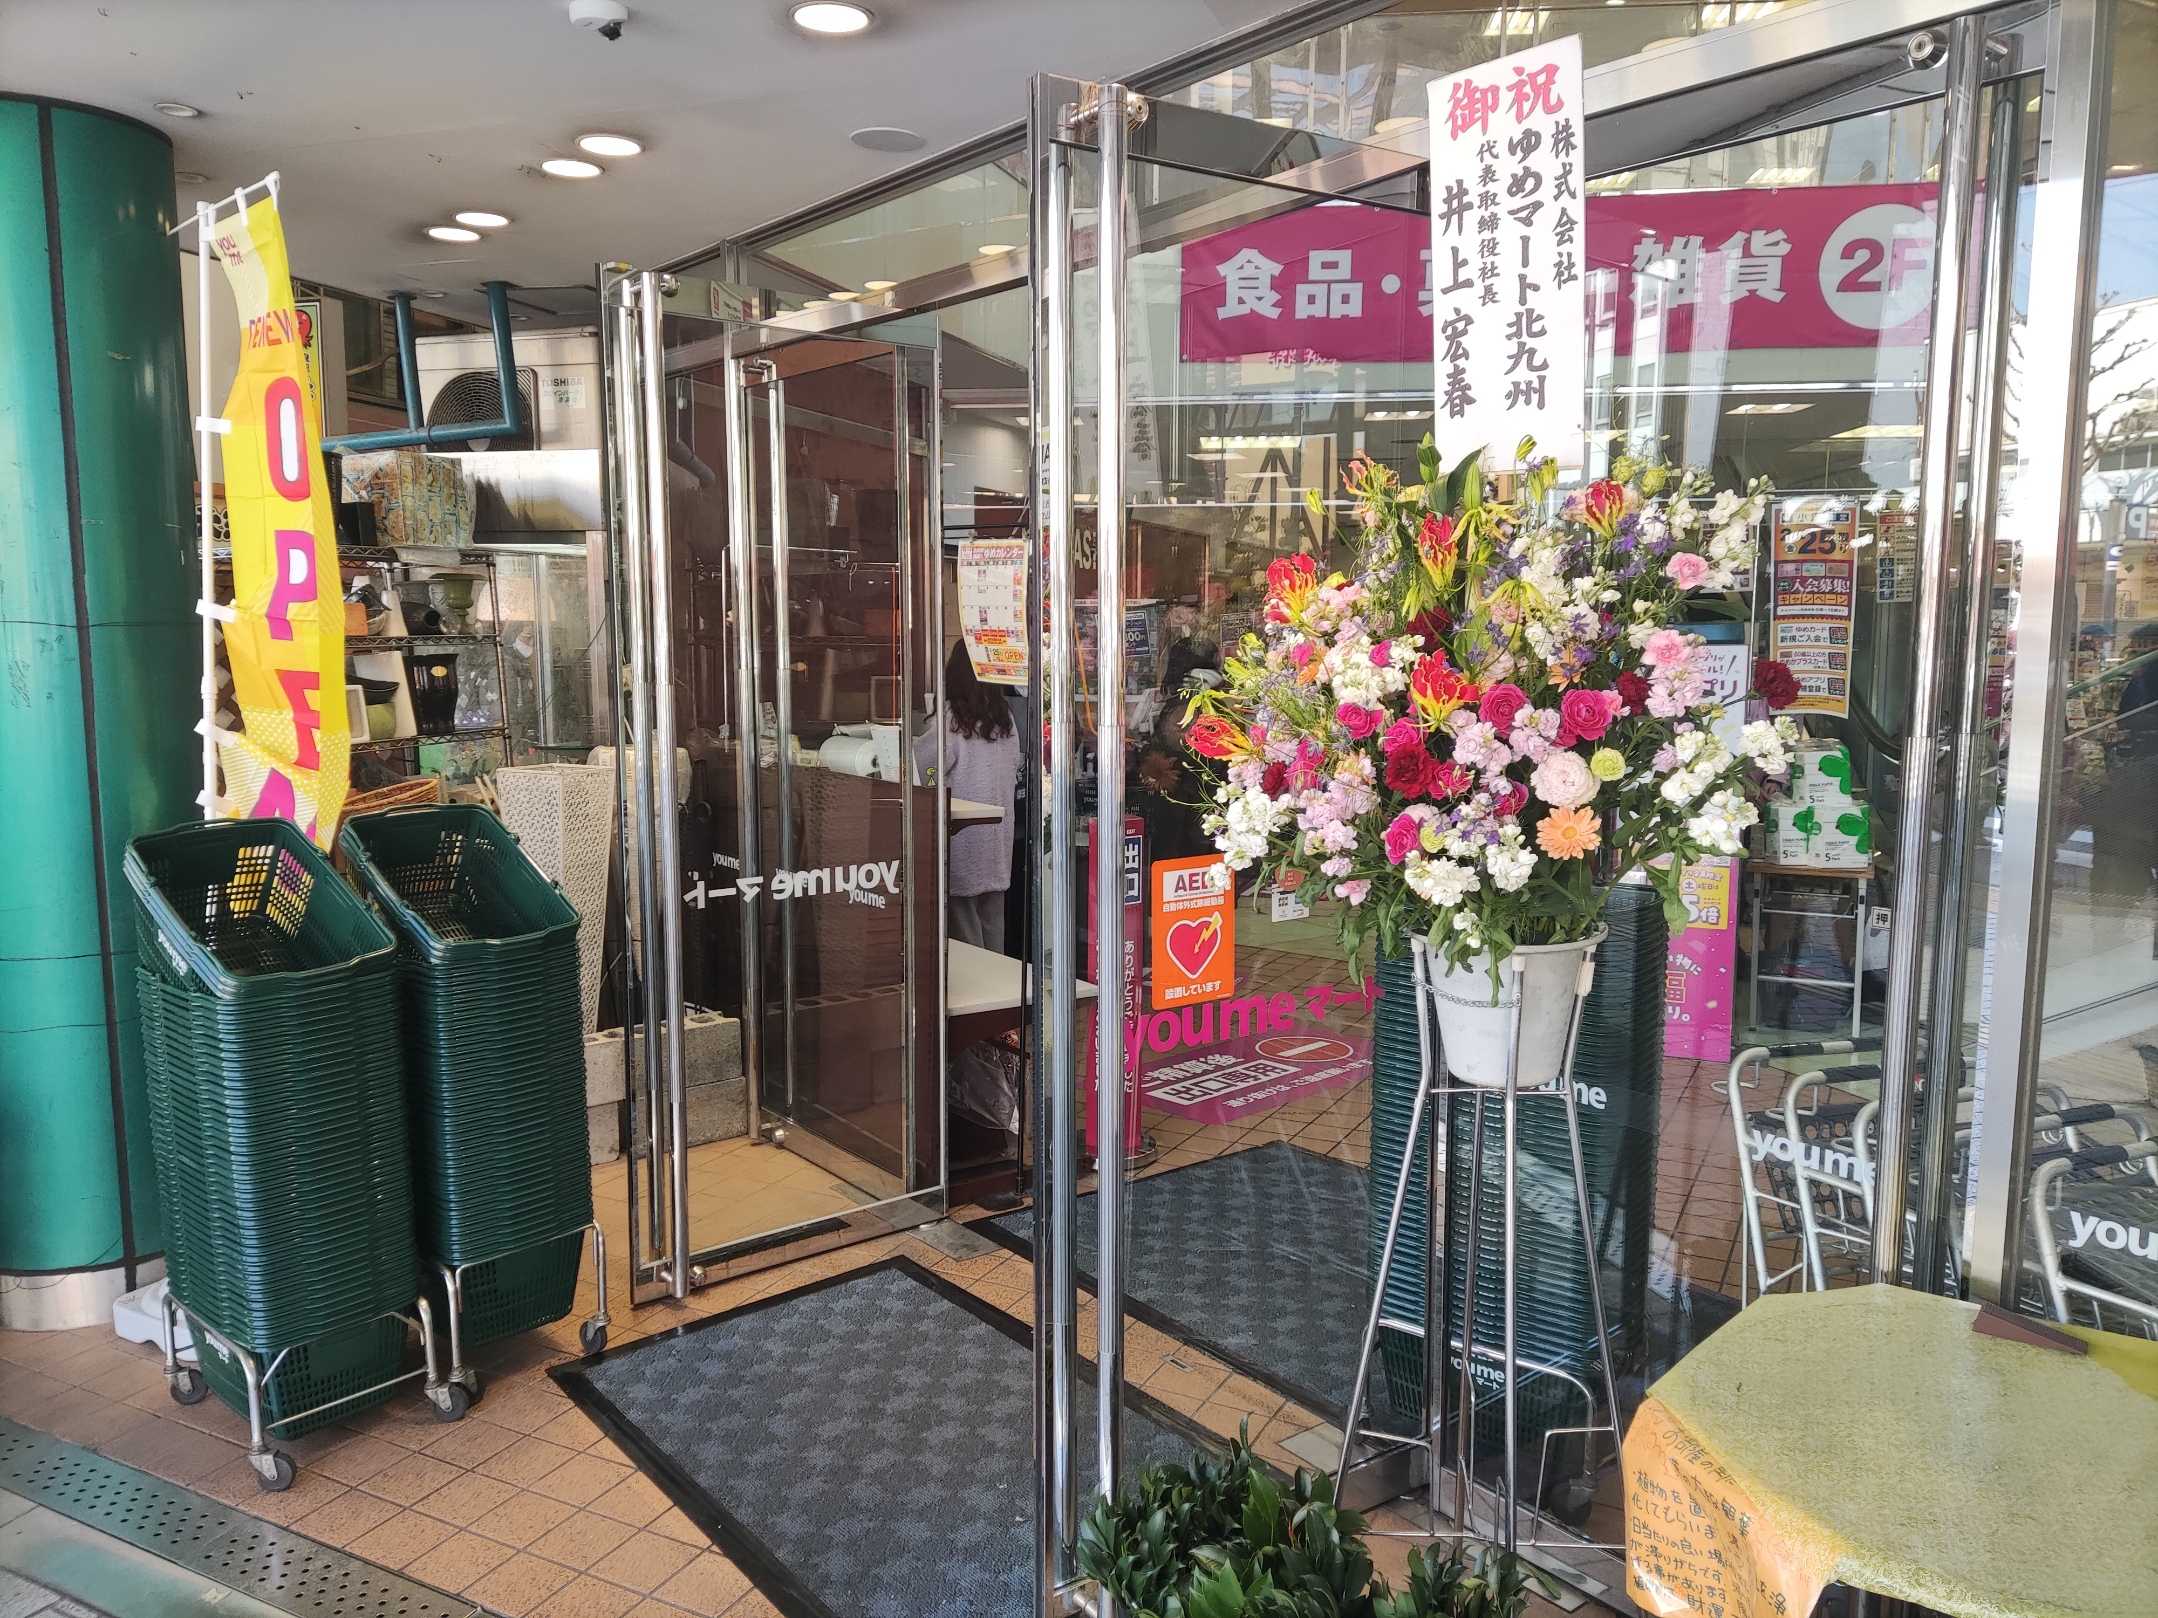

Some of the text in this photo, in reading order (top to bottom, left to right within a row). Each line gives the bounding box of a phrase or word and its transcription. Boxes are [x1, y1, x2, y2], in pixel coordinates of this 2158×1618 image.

[1550, 119, 1579, 291] 株式会社
[1476, 139, 1502, 307] 代表取締役社長
[216, 235, 237, 254] you
[1506, 127, 1550, 411] ゆめマート北九州
[1215, 247, 1433, 322] 食品・
[1836, 237, 1932, 293] 2F
[541, 377, 583, 387] TOSHIBA
[1779, 595, 1847, 604] キャンペーン
[1780, 634, 1828, 643] 新規ご入会で
[1809, 795, 1815, 804] 5
[1783, 850, 1789, 858] 5
[1825, 853, 1831, 861] 5
[1164, 980, 1222, 1001] 設置しています
